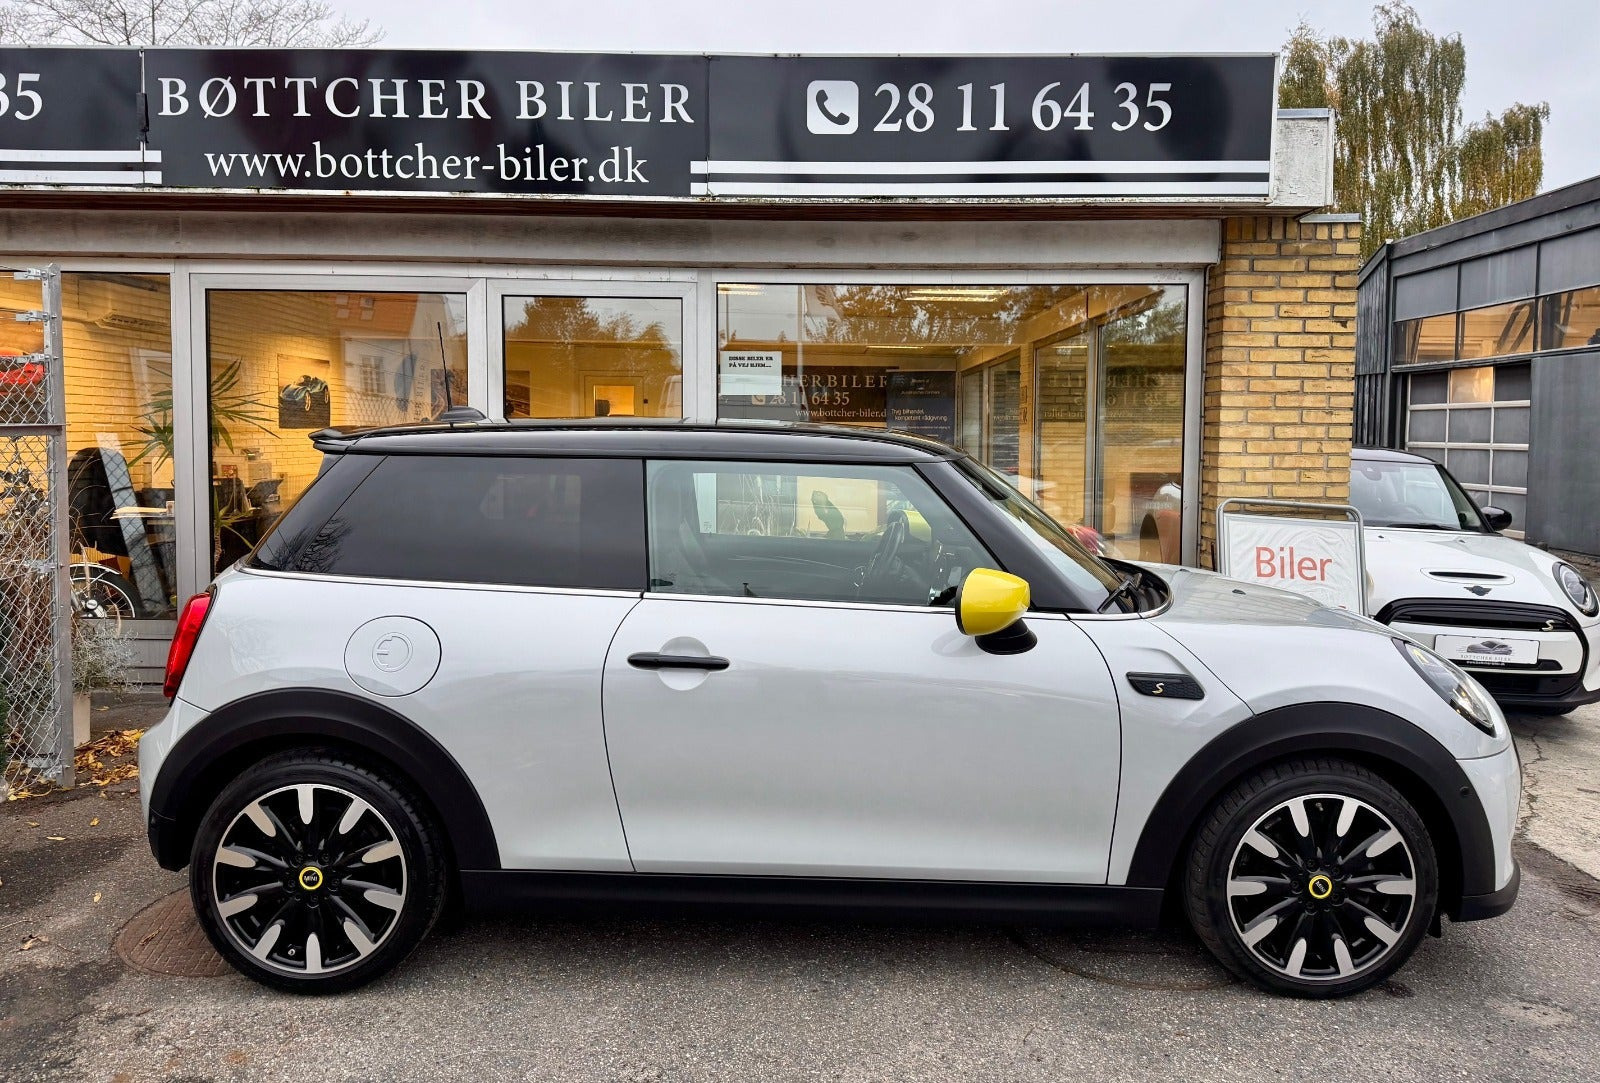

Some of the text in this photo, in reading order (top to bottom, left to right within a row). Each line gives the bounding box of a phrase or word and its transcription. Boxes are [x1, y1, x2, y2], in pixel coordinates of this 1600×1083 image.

[157, 76, 695, 124] BØTTCHER BILER
[873, 81, 1172, 133] 28 11 64 35
[203, 141, 650, 184] www.bottcher-biler.dk
[811, 391, 829, 405] 64
[833, 391, 850, 405] 35
[1255, 546, 1333, 582] Biler
[1542, 620, 1555, 631] S
[1151, 682, 1165, 695] S
